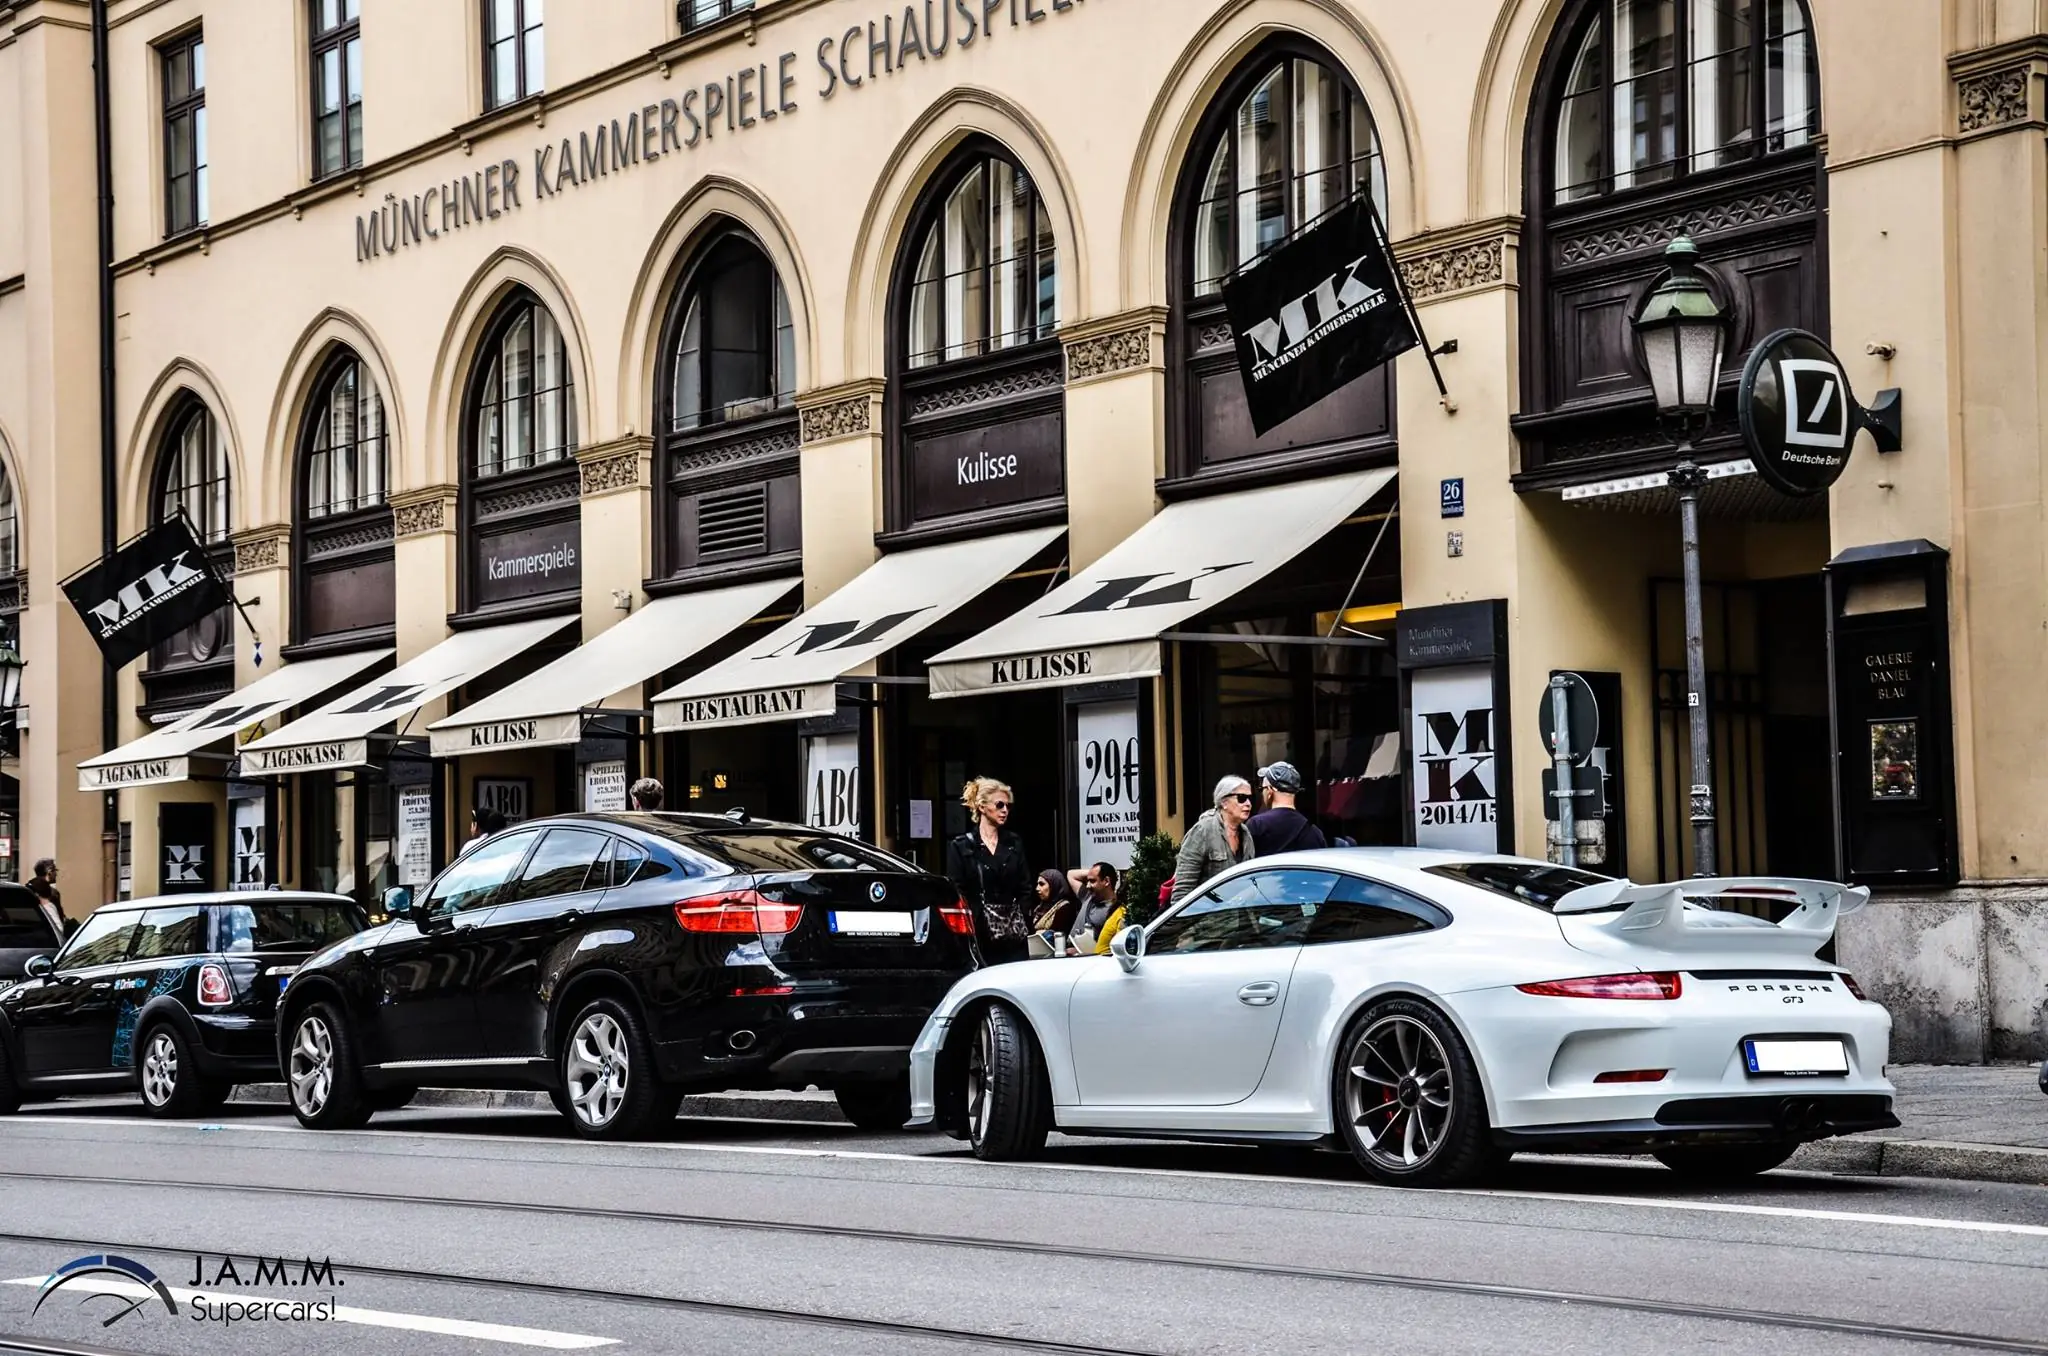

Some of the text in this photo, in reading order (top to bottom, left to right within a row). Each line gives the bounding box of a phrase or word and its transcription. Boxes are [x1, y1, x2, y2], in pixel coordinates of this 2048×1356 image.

[355, 0, 1084, 263] MÜNCHNER KAMMERSPIELE SCHAUSP
[1242, 255, 1382, 371] MK
[1252, 292, 1388, 383] MÜNCHNER KAMMERSPIELE
[957, 451, 1017, 485] Kulisse
[1782, 450, 1825, 465] Deutsche
[1443, 481, 1460, 500] 26
[488, 542, 576, 580] Kammerspiele
[87, 550, 203, 634] MK
[142, 572, 206, 613] KAMMERSPIELE
[991, 651, 1091, 684] KULISSE
[1865, 652, 1913, 667] GALERIE
[1870, 669, 1911, 683] DANIEL
[681, 688, 806, 723] RESTAURANT
[1878, 687, 1906, 699] BLAU
[471, 720, 537, 746] KULISSE
[1418, 708, 1495, 757] M
[261, 743, 346, 769] TAGESKASSE
[98, 760, 170, 784] TAGESKASSE
[1085, 737, 1141, 806] 29€
[1420, 756, 1496, 803] K
[483, 785, 522, 816] ABO
[1420, 803, 1497, 826] 2014/15
[1085, 812, 1120, 824] JUNGES
[1093, 835, 1117, 844] FREIER
[1728, 984, 1834, 993] PORSCHE
[1782, 996, 1805, 1004] GT3
